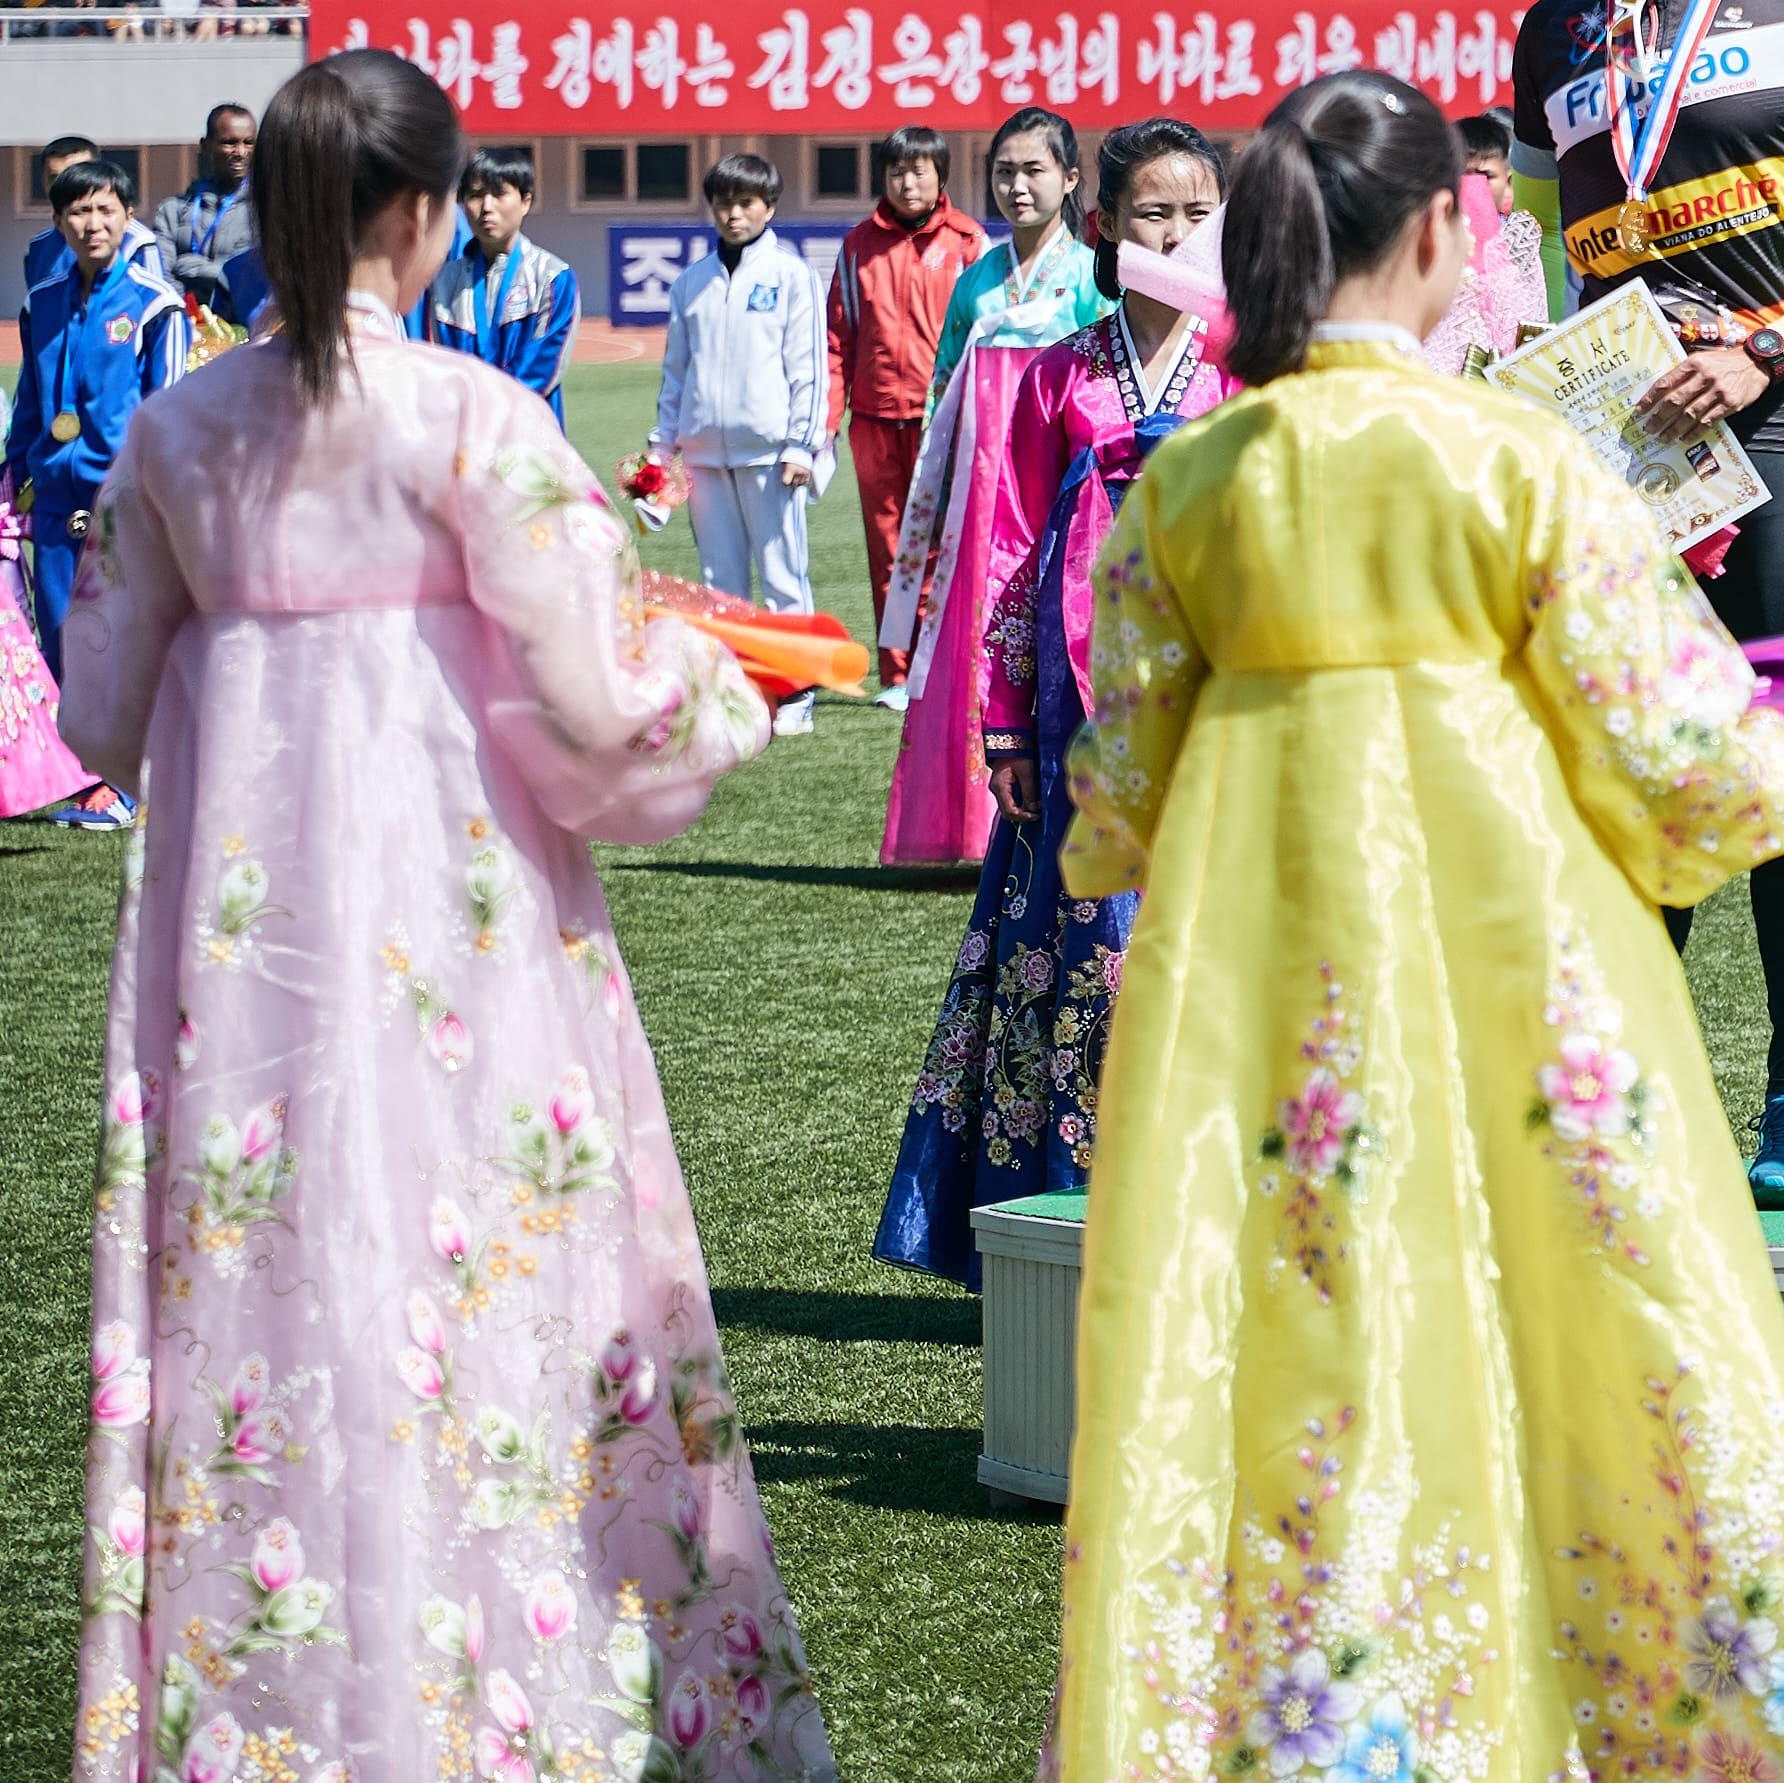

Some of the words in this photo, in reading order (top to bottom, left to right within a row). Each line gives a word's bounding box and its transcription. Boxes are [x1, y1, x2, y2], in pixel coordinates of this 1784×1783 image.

[543, 16, 737, 111] 경애하는
[1137, 11, 1263, 106] 나라로
[1572, 173, 1777, 261] Intemarché
[1663, 230, 1696, 247] VIANA
[1698, 223, 1714, 238] DO
[1554, 349, 1631, 401] CERTIFICATE
